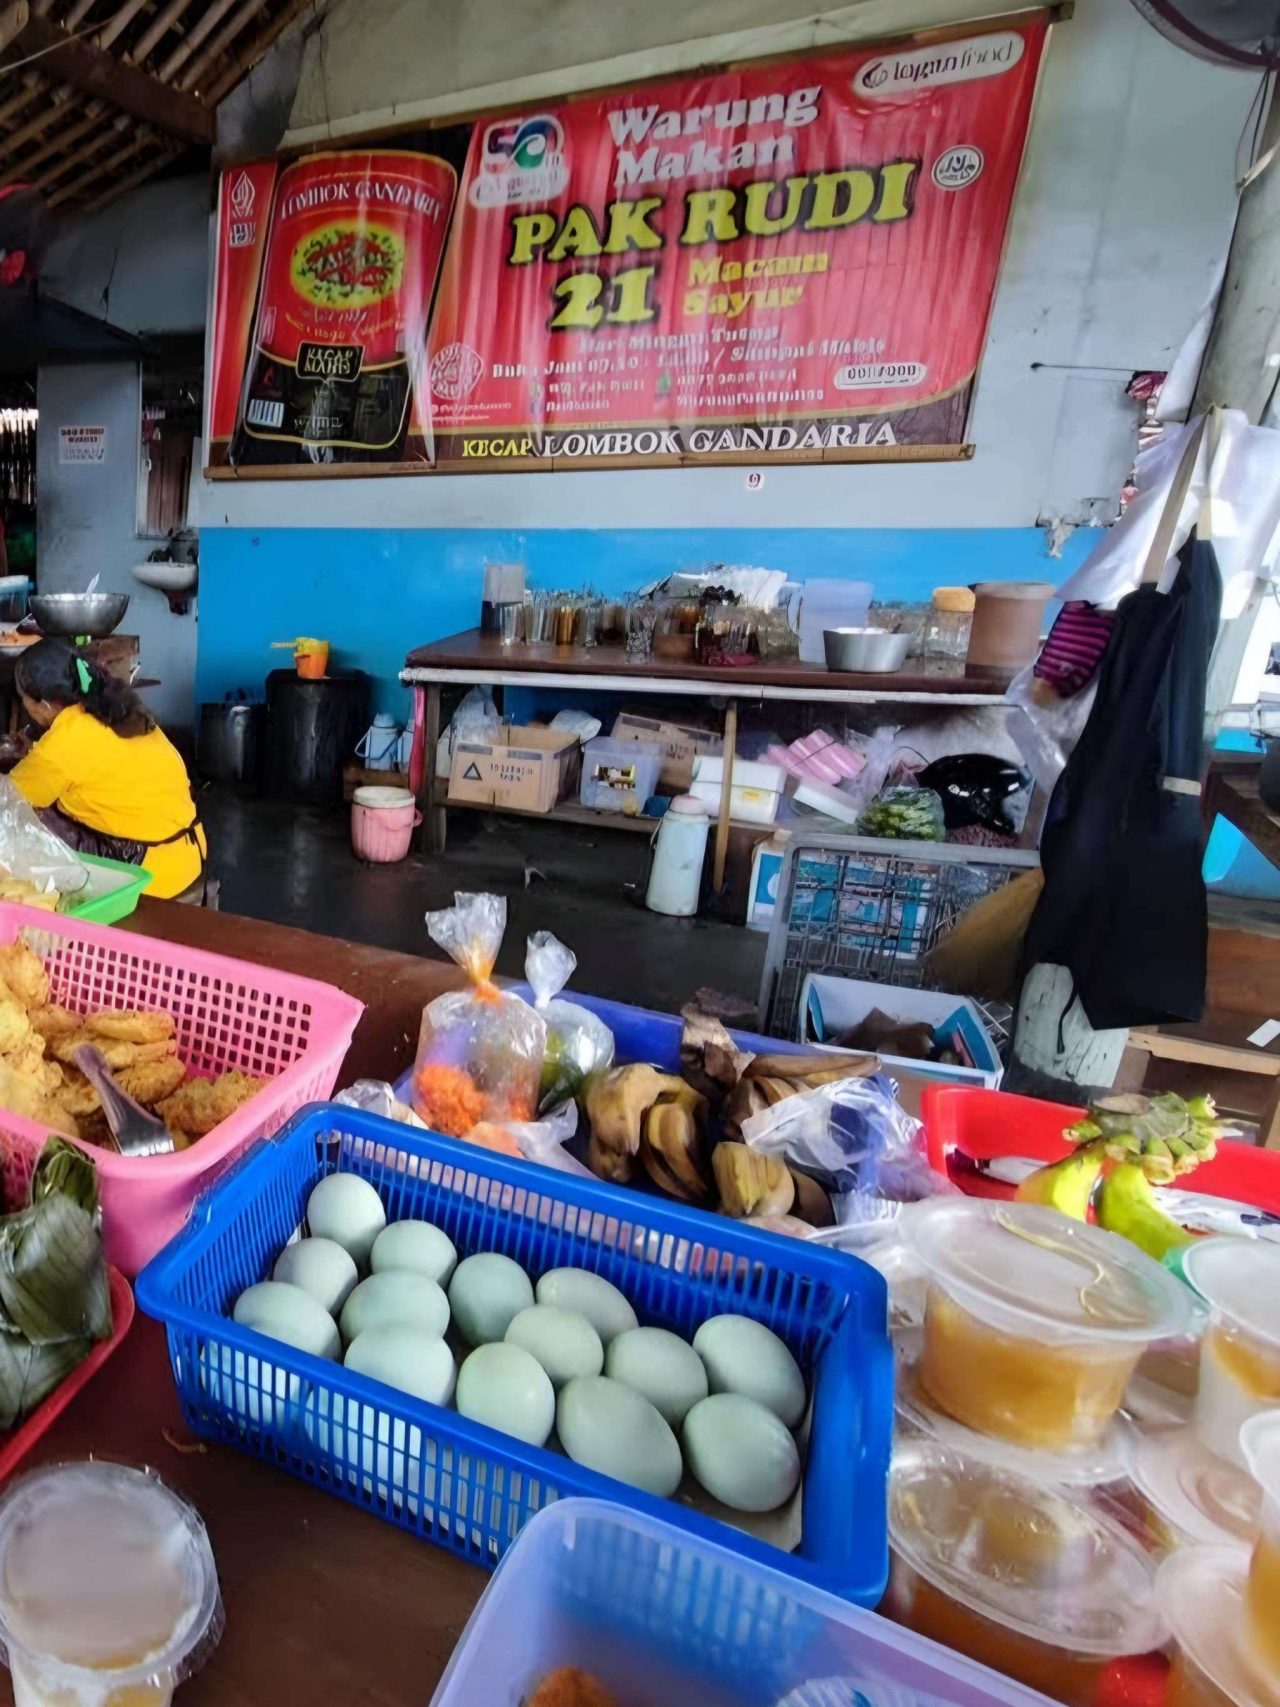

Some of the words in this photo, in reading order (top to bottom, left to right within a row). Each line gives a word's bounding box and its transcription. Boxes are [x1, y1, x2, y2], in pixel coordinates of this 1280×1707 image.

[608, 85, 821, 145] Warung
[614, 134, 794, 186] Makan
[509, 198, 663, 264] PAK
[681, 163, 917, 245] RUDI
[550, 266, 656, 330] 21
[462, 439, 532, 457] KECAP
[540, 430, 684, 457] LOMBOK
[688, 421, 898, 453] GANDARIA
